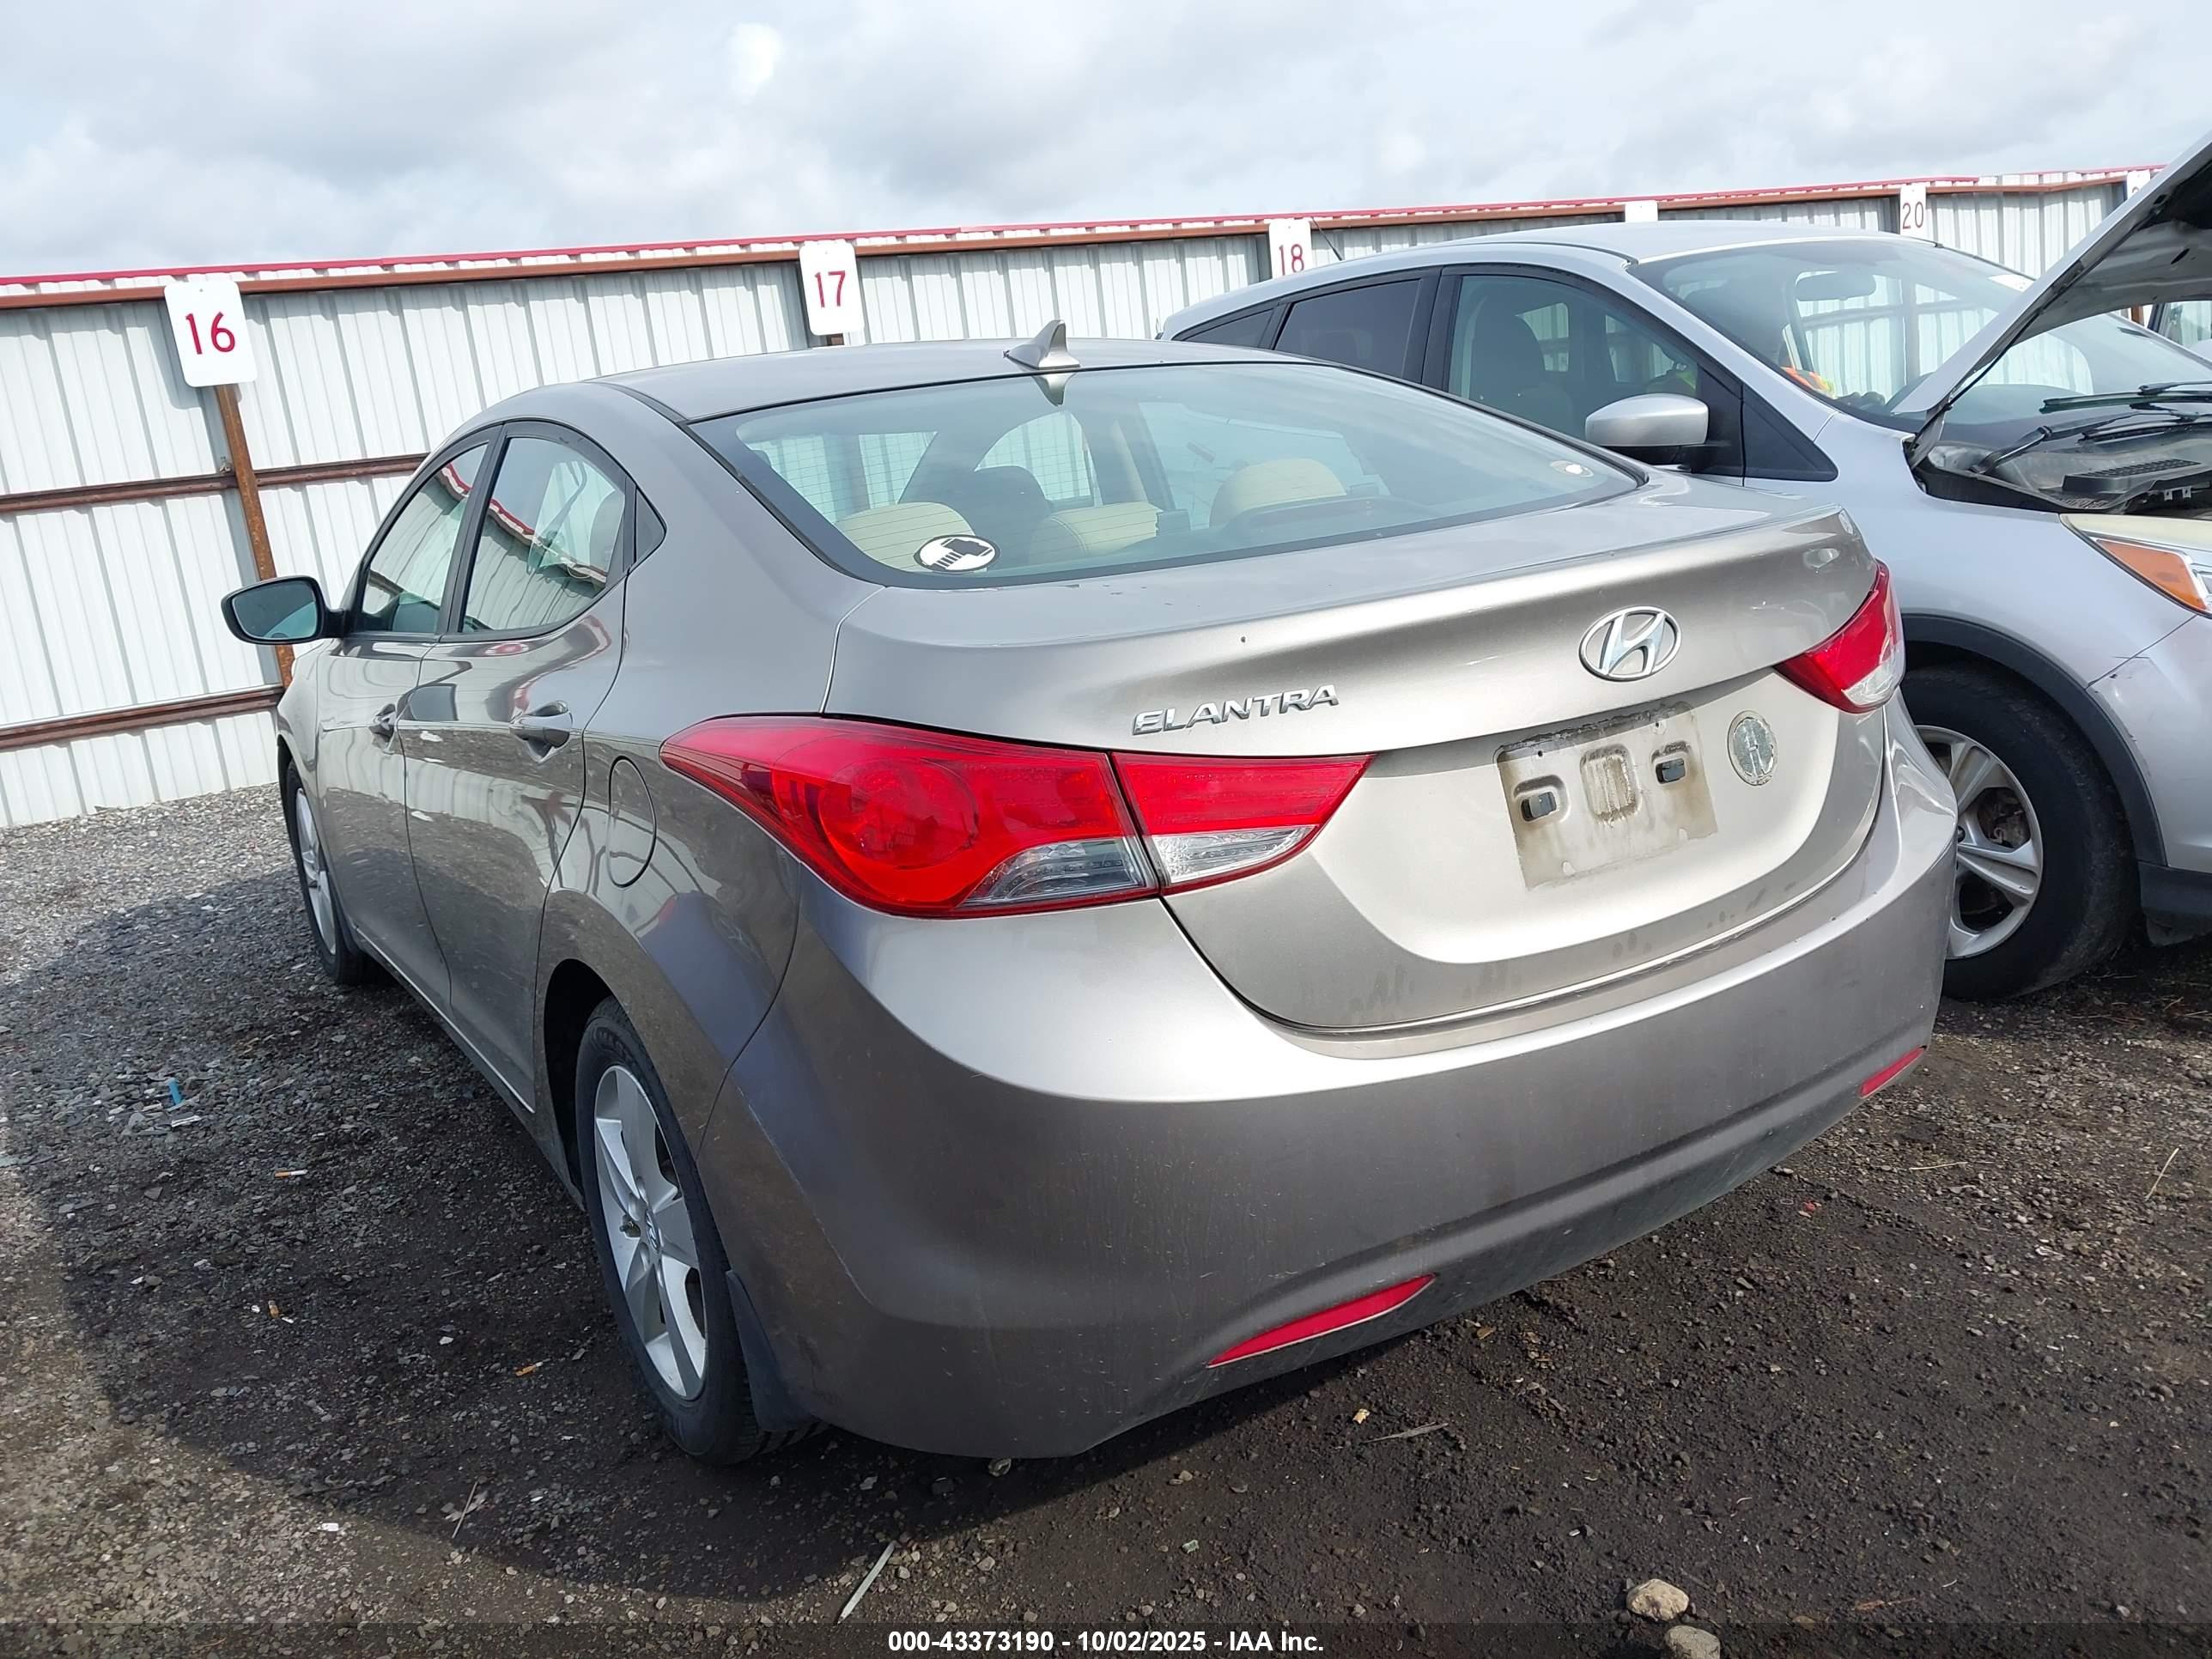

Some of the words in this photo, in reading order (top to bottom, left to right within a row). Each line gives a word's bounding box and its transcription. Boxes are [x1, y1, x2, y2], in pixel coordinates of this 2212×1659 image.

[1902, 201, 1924, 229] 20
[1279, 244, 1304, 276] 18
[814, 270, 846, 308] 17
[185, 311, 235, 355] 16
[1132, 684, 1340, 736] ELANTRA
